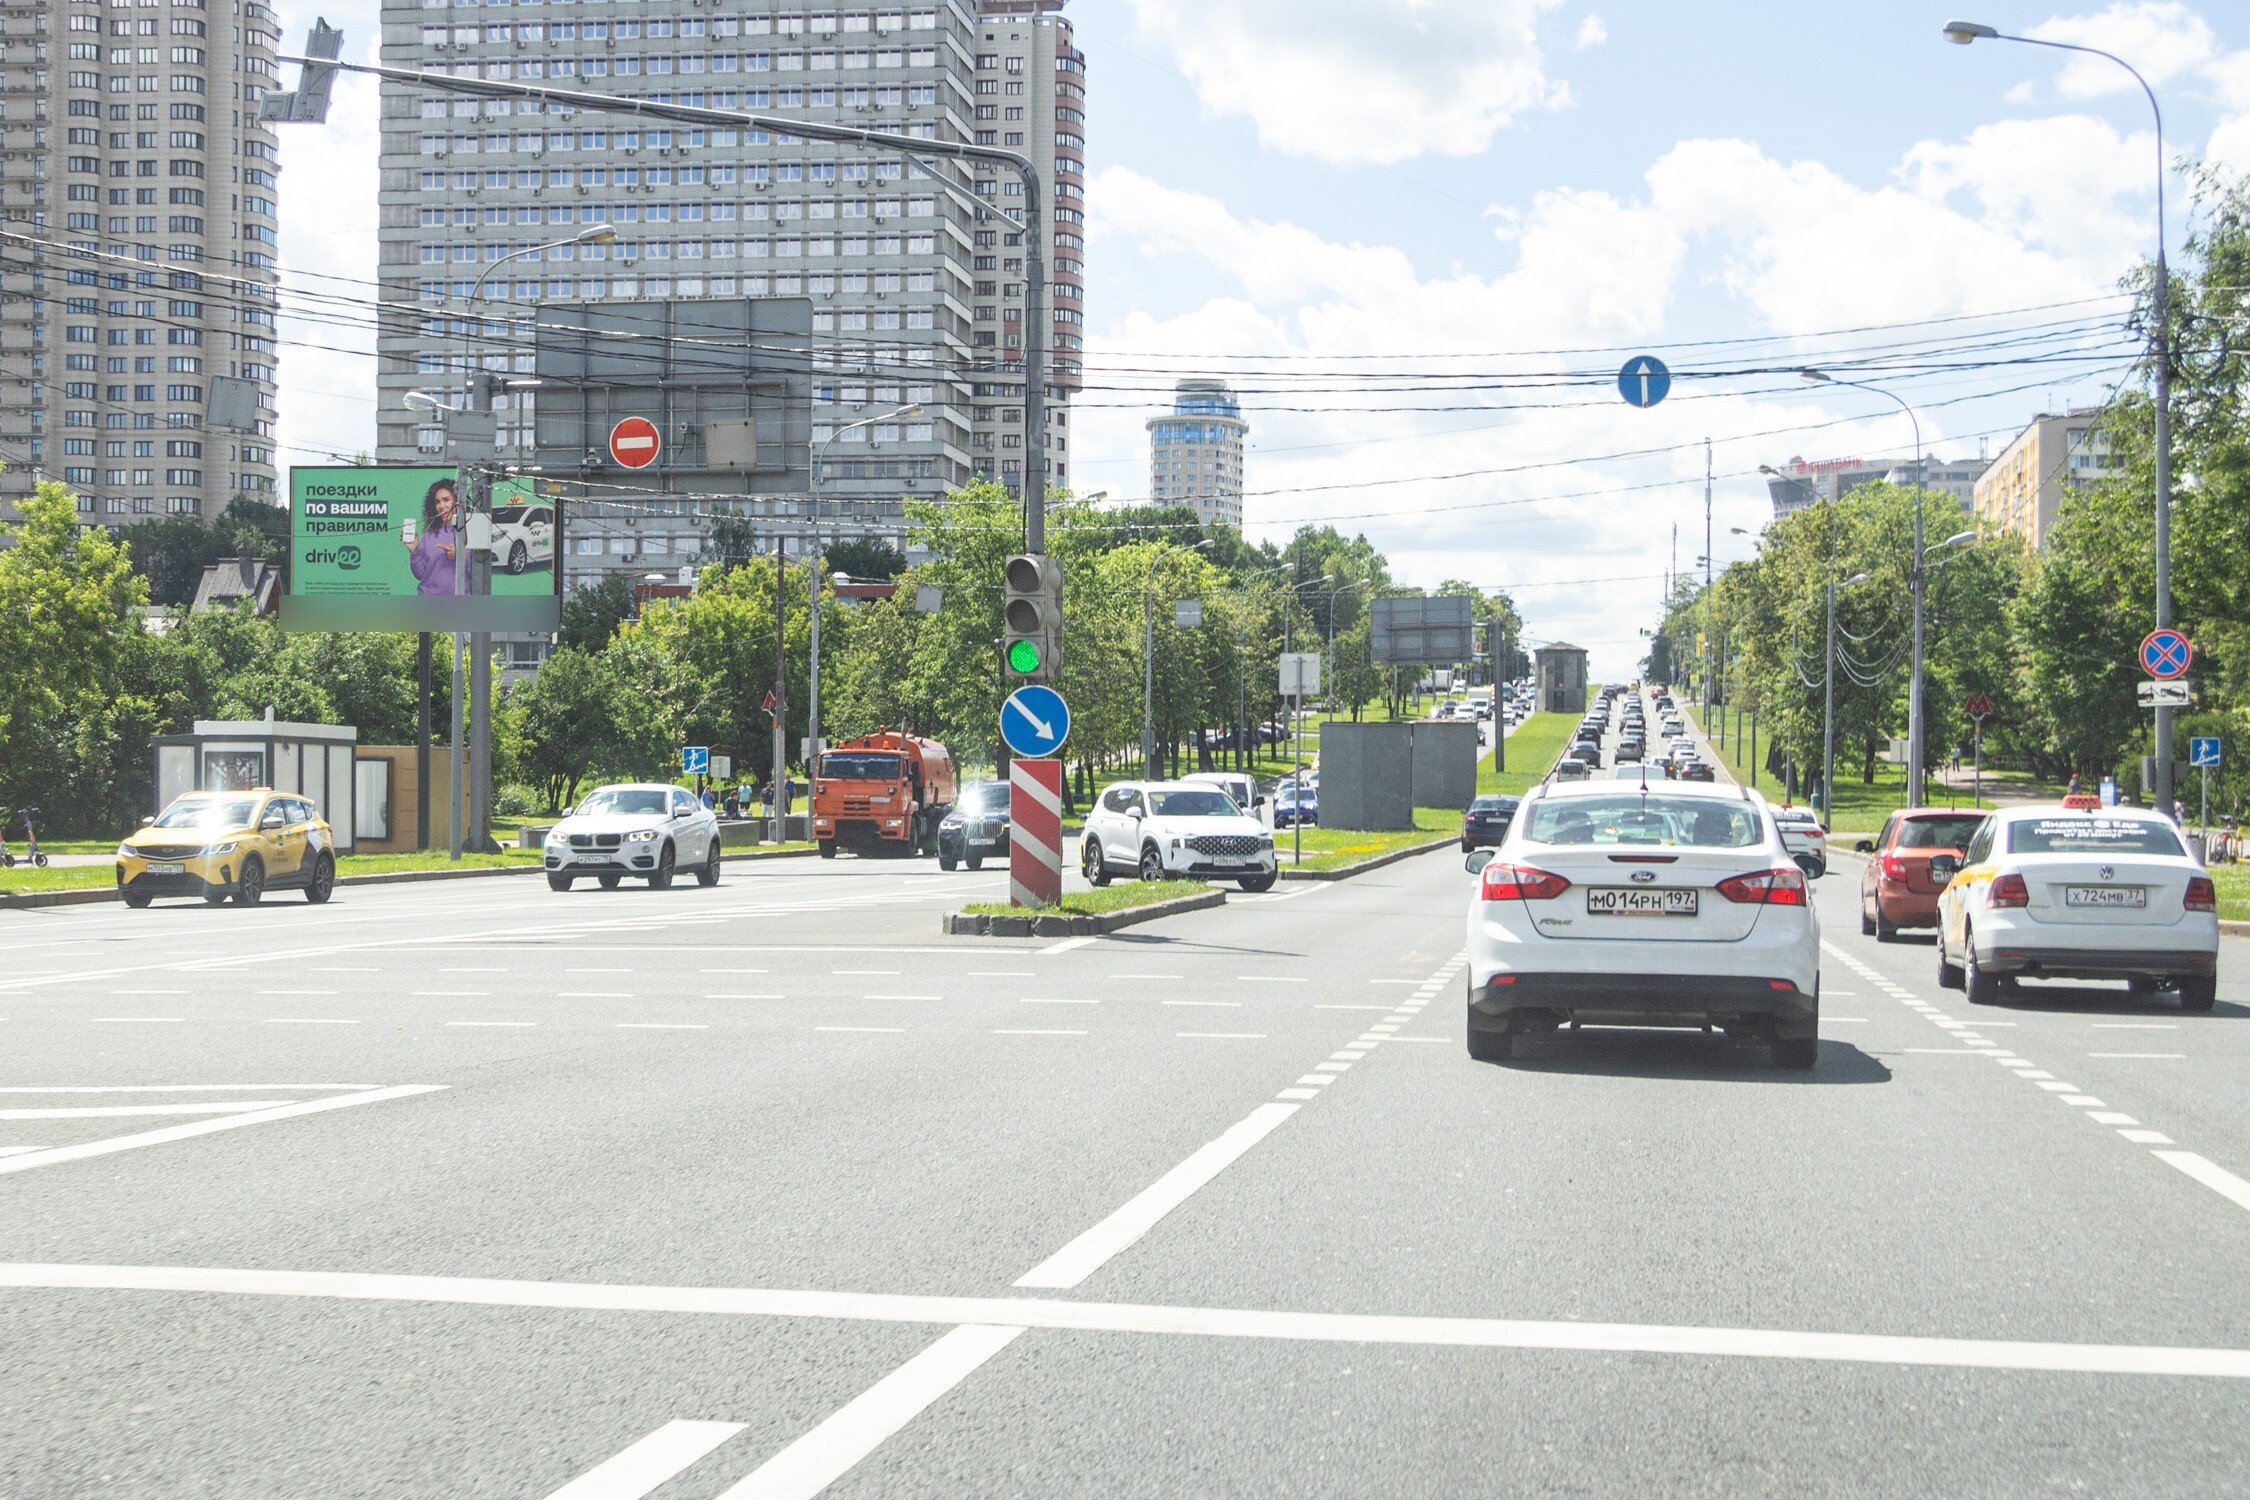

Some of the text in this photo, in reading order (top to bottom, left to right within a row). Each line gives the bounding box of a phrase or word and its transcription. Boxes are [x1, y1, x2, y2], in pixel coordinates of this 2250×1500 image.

[306, 485, 377, 499] поездки
[305, 503, 388, 516] по вашим
[305, 521, 388, 536] правилам
[305, 547, 361, 569] drivee
[1594, 892, 1691, 908] М014РН 197
